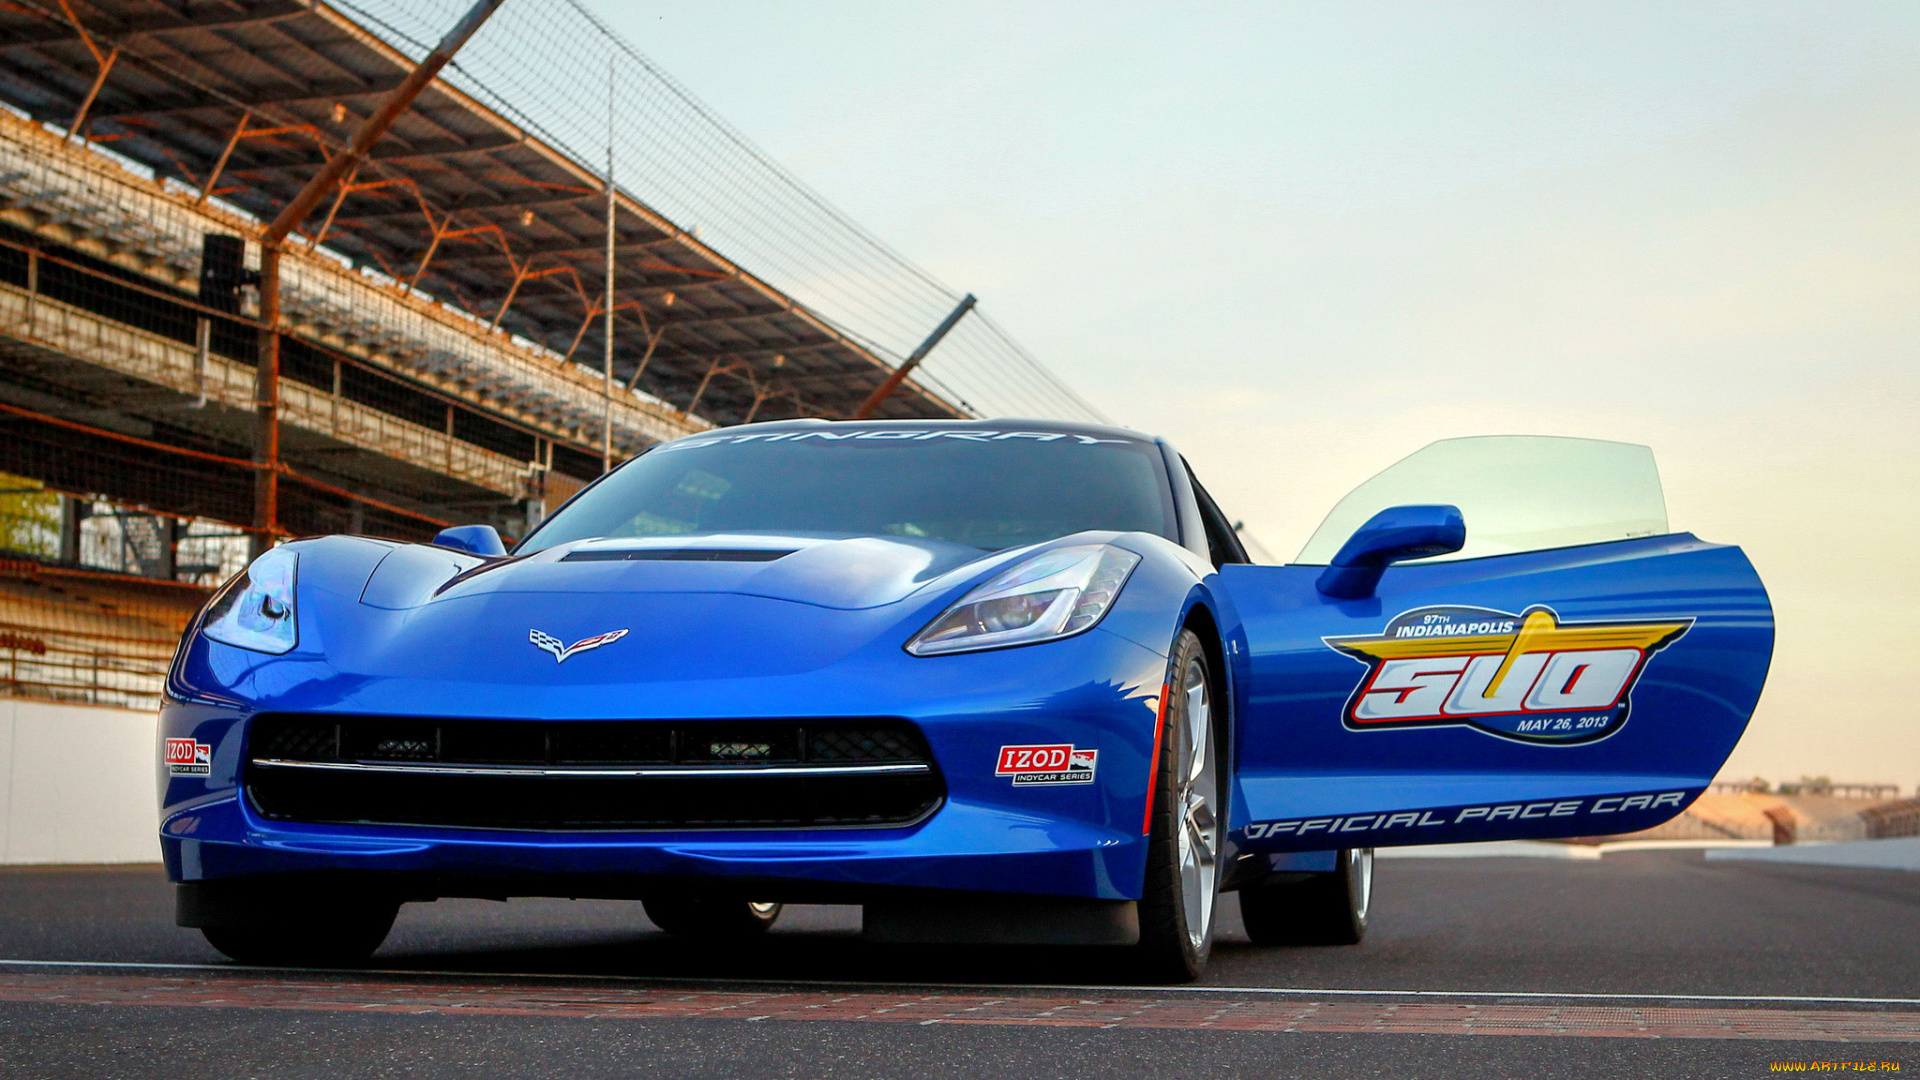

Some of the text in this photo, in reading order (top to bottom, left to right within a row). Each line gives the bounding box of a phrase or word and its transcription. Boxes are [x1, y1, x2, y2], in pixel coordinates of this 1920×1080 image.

[670, 430, 1132, 449] STINGRAY
[1424, 614, 1450, 625] 97TH
[1395, 621, 1514, 638] INDIANAPOLIS
[1516, 716, 1609, 732] MAY 26, 2013
[167, 743, 192, 759] IZOD
[1004, 750, 1066, 768] IZOD
[1060, 772, 1091, 780] SERIES
[1244, 791, 1685, 840] OFFICIAL PACE CAR
